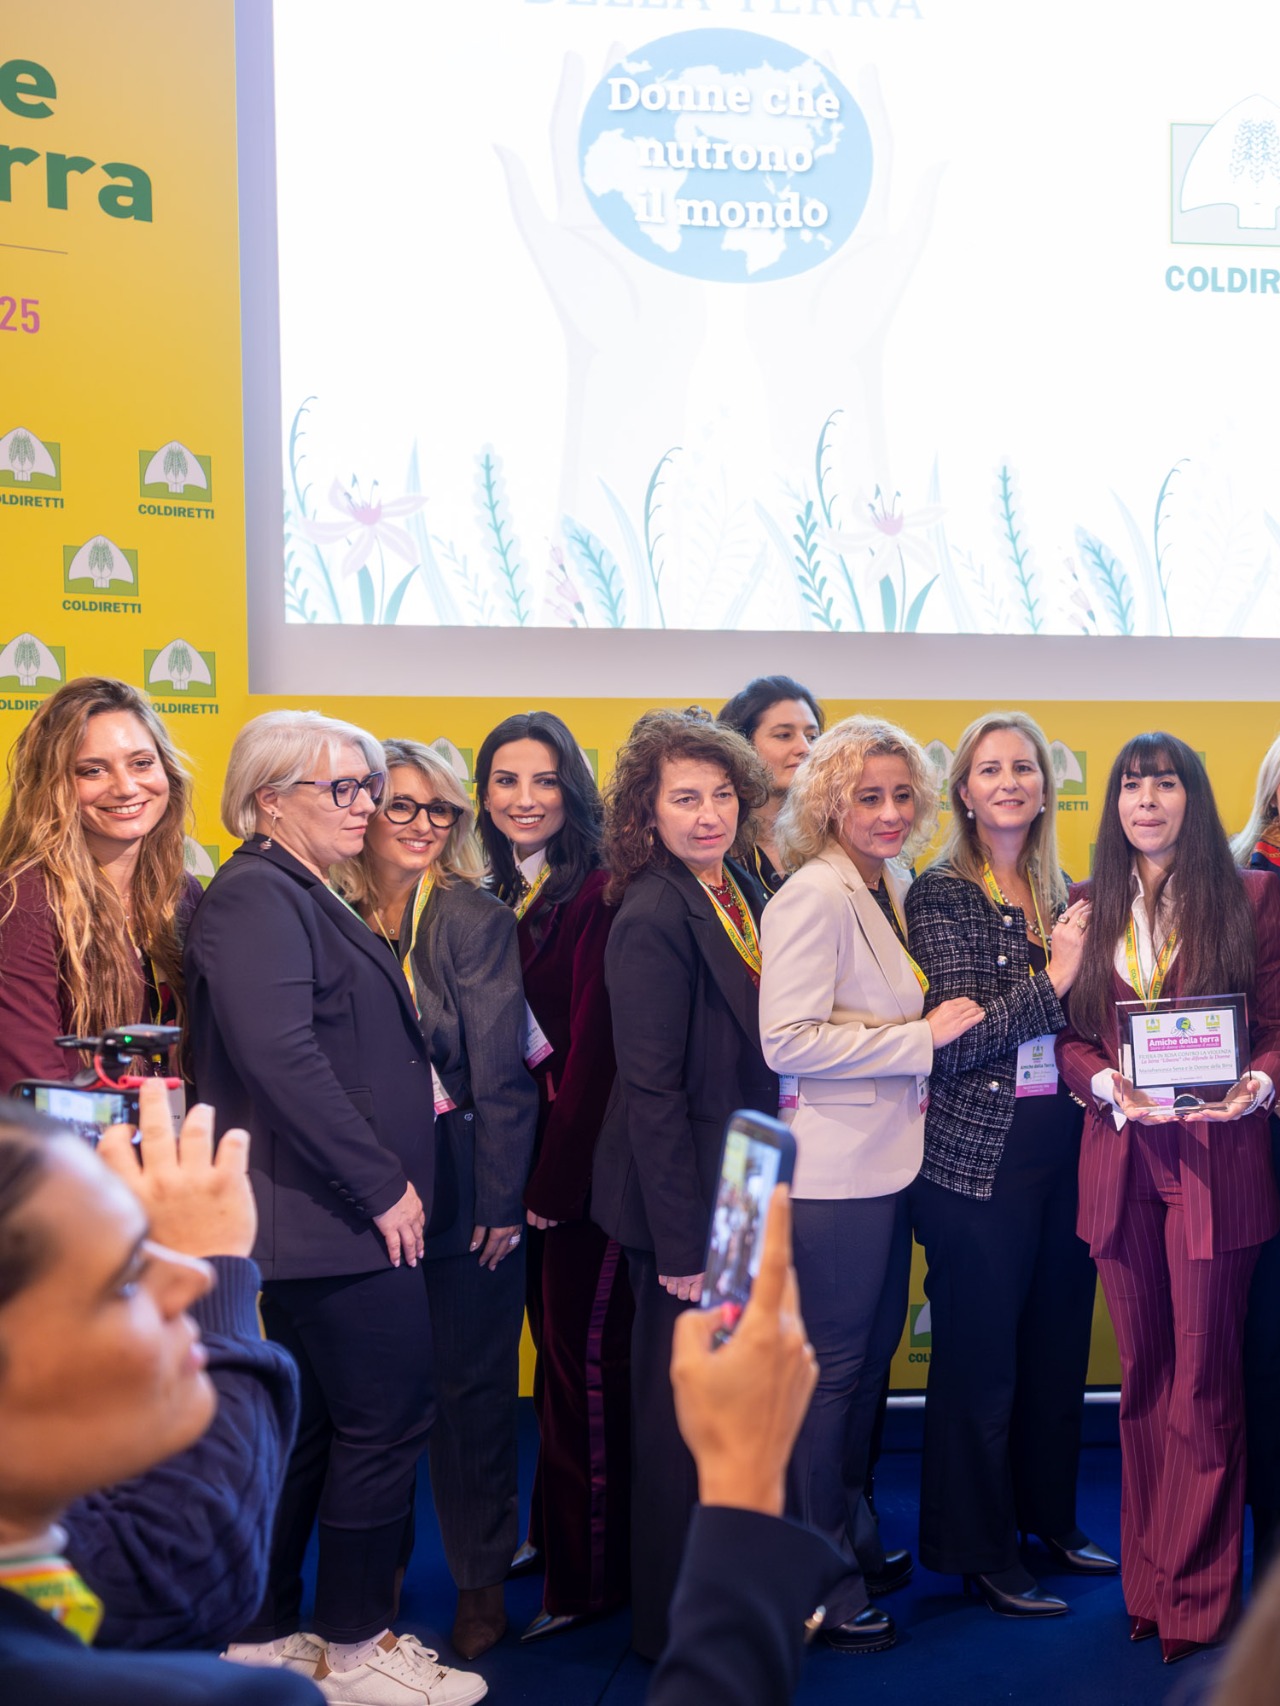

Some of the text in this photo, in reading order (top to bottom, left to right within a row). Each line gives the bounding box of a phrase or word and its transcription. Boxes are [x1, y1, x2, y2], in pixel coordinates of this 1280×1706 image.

[608, 77, 840, 119] Donne che
[635, 137, 813, 173] nutrono
[635, 187, 829, 229] il mondo
[138, 504, 215, 519] COLDIRETTI
[62, 600, 142, 614] COLDIRETTI
[152, 703, 219, 714] OLDIRETTI
[1057, 801, 1089, 811] RETTI
[1149, 1039, 1177, 1047] Amiche
[1179, 1037, 1198, 1045] della
[1200, 1035, 1219, 1043] terra
